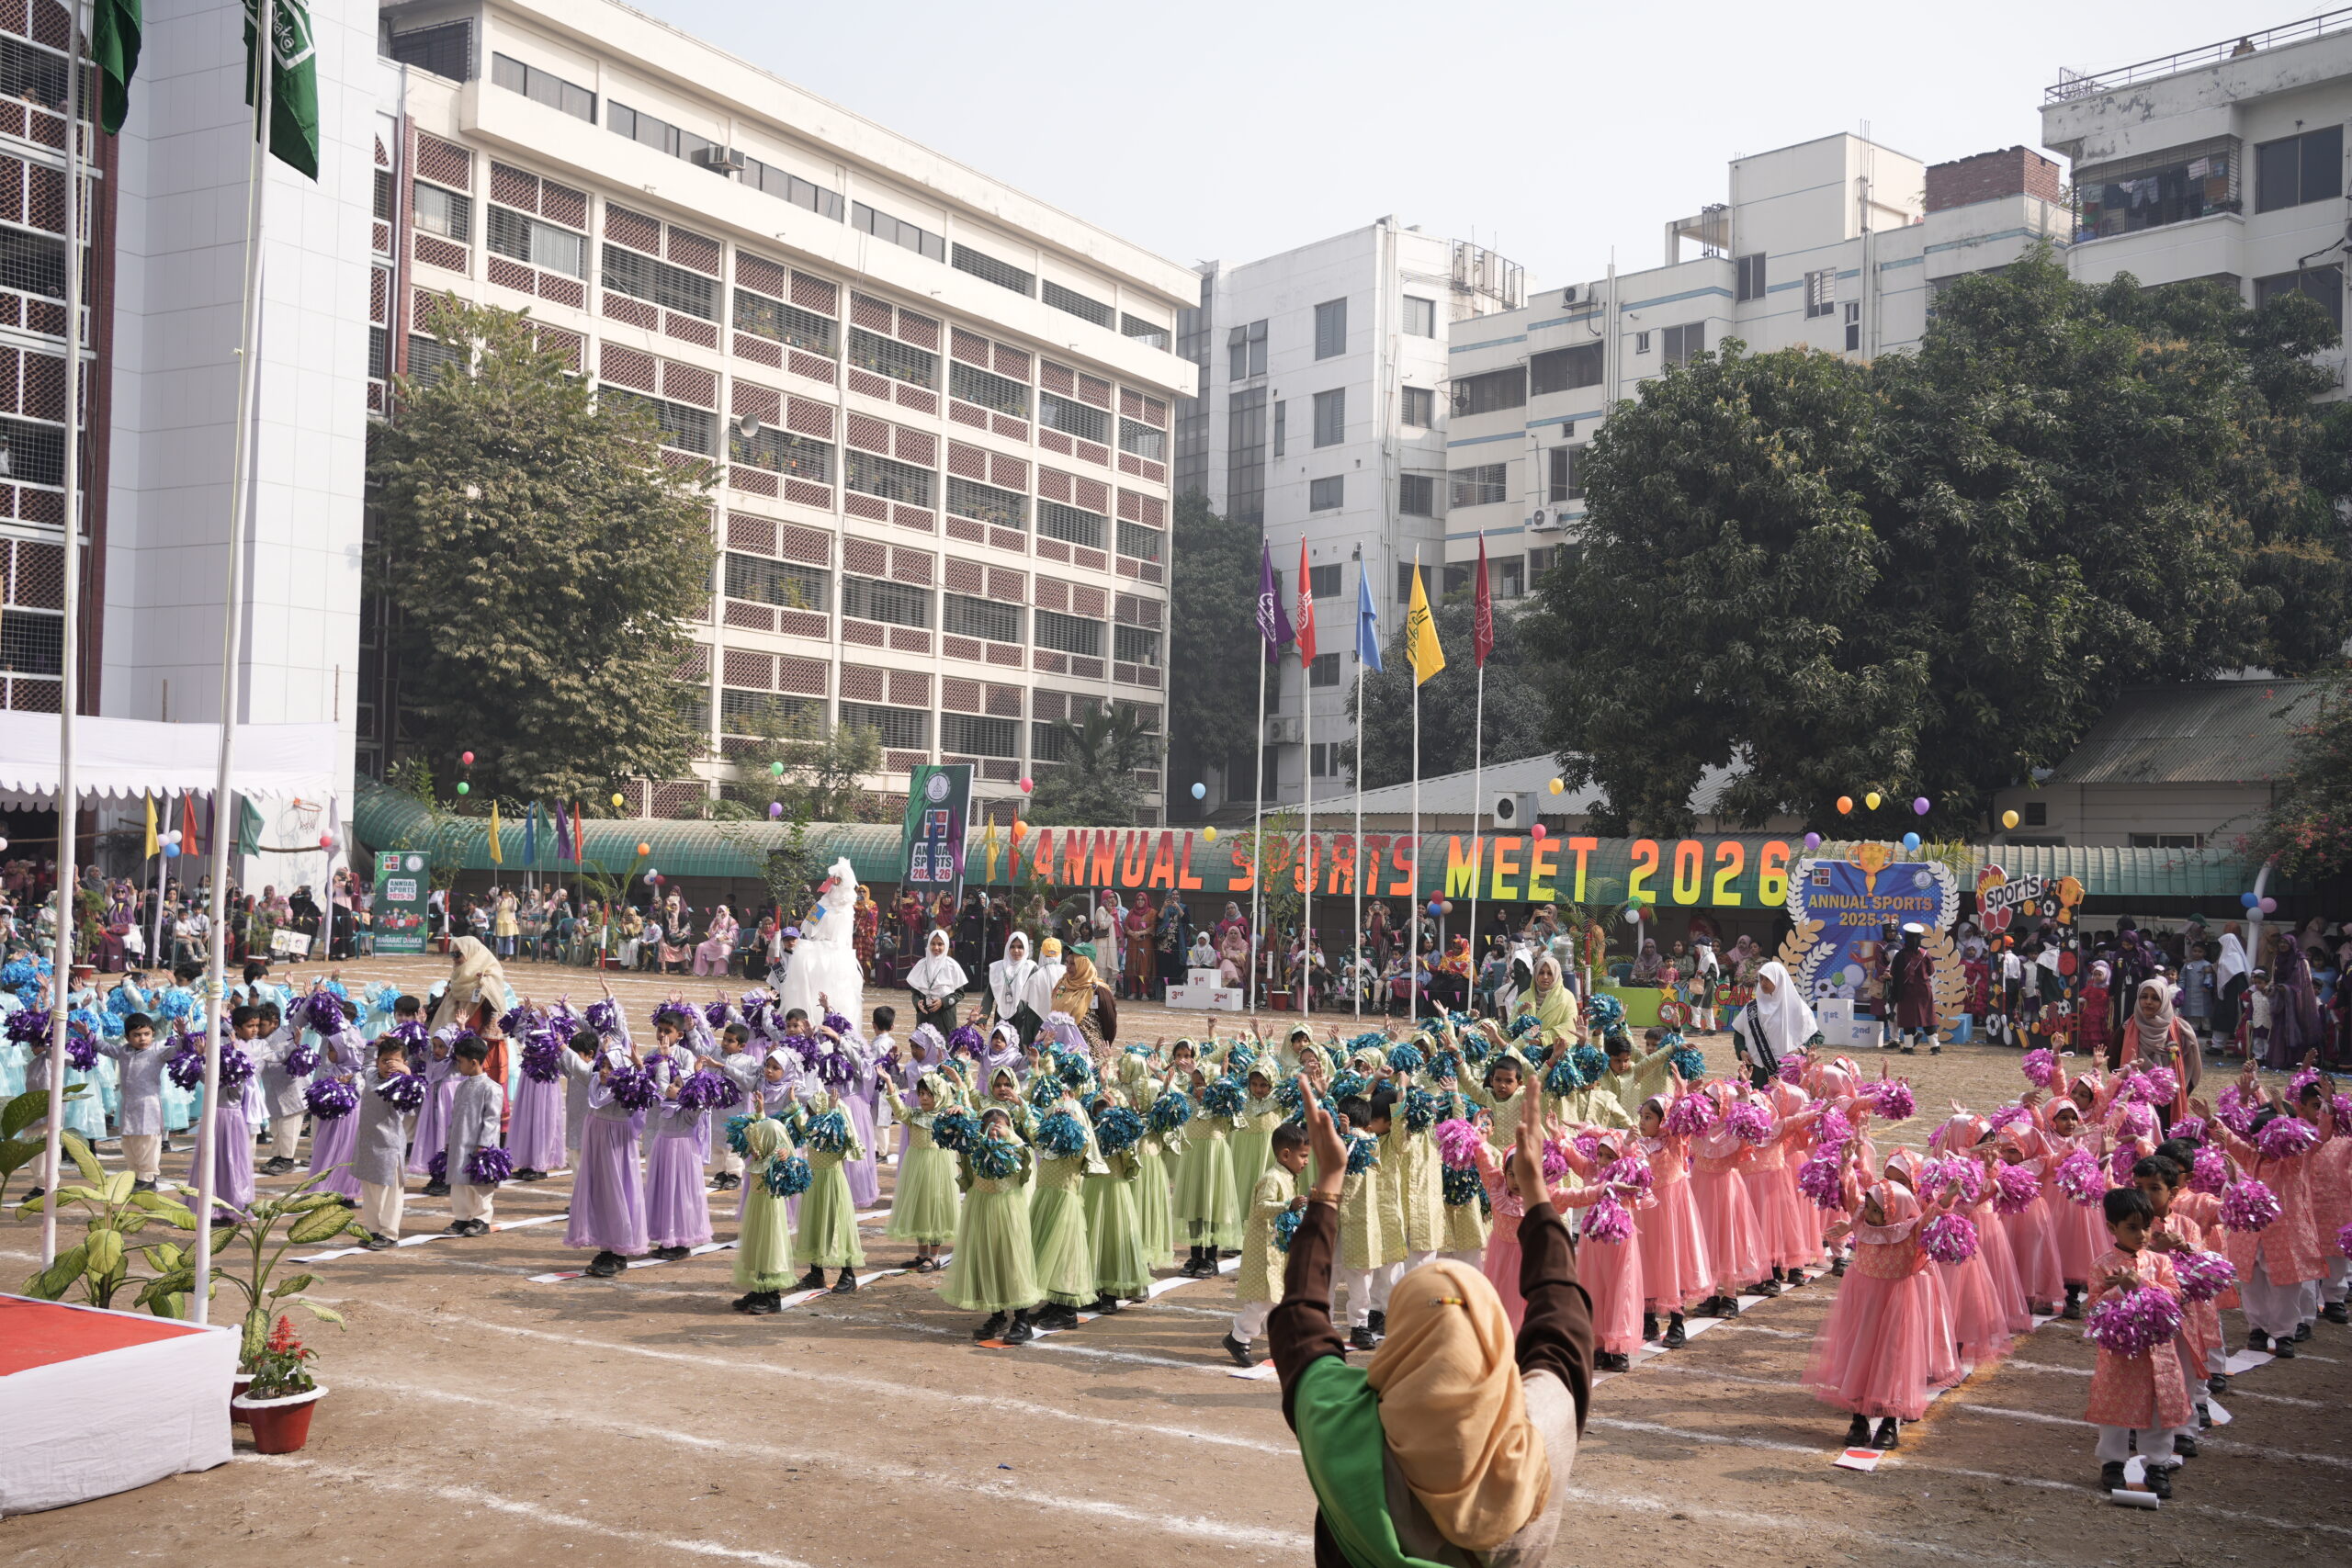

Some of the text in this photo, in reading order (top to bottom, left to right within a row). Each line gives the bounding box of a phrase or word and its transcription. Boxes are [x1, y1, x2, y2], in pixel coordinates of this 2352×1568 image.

[914, 856, 952, 868] SPRTS
[1030, 829, 1791, 907] ANNUAL SPORTS MEET 2026
[912, 868, 951, 880] 202-26
[1986, 874, 2040, 912] sports
[1808, 894, 1933, 911] ANNUAL SPORTS
[1171, 990, 1184, 1000] 3rd
[1214, 993, 1227, 1003] 2nd
[1715, 984, 1754, 1007] CAN
[1823, 1011, 1839, 1024] 1st
[1851, 1026, 1871, 1039] 2nd
